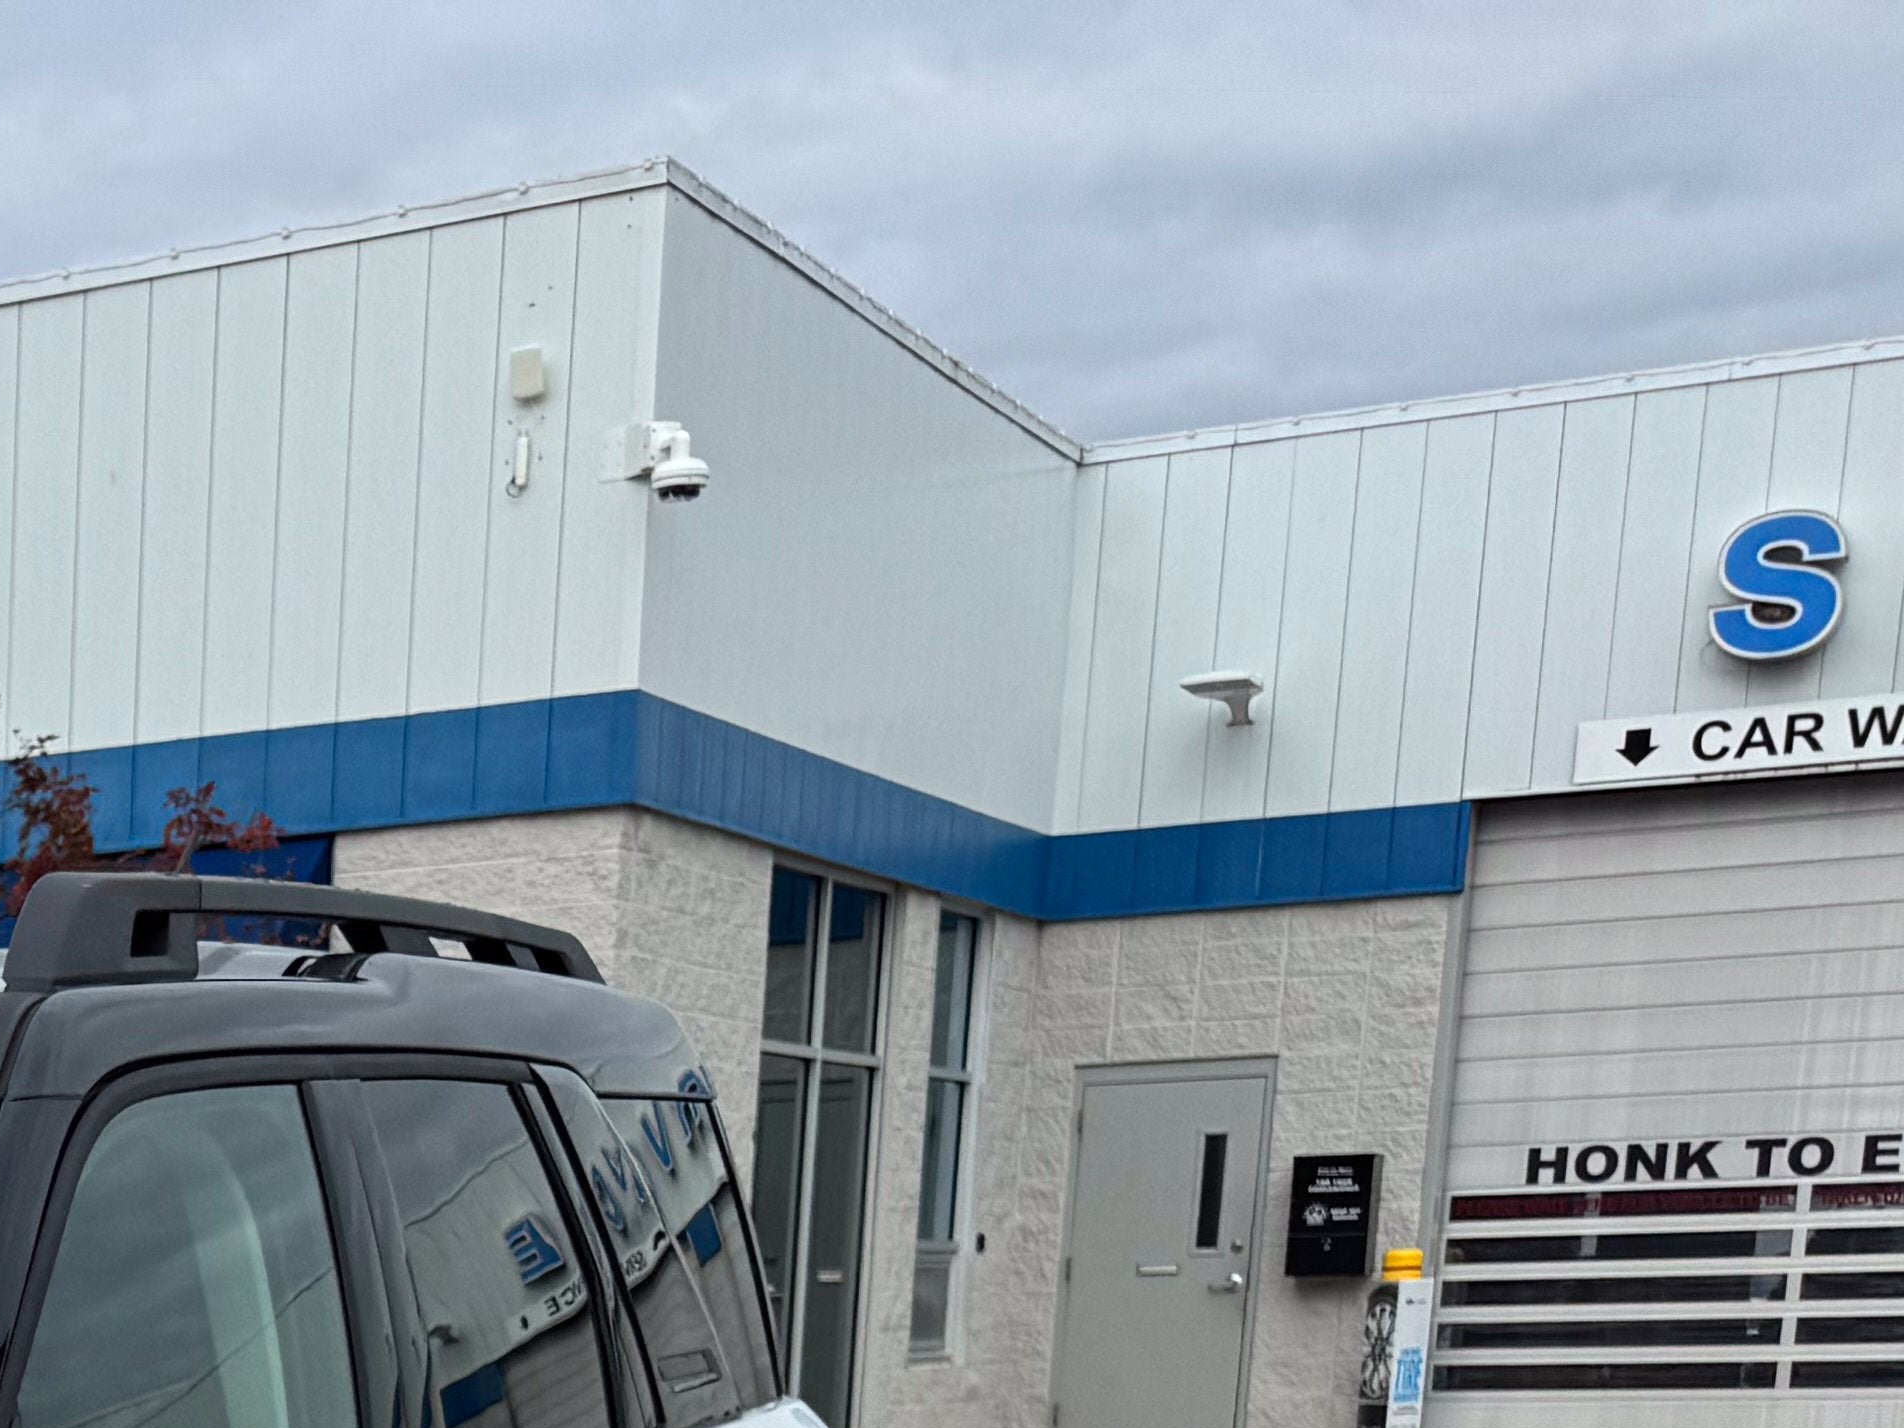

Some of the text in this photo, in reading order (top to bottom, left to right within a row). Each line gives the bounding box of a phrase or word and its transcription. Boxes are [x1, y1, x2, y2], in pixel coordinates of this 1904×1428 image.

[1708, 509, 1849, 660] S
[1692, 704, 1904, 761] CAR W
[1525, 1140, 1723, 1185] HONK
[1745, 1136, 1835, 1178] TO
